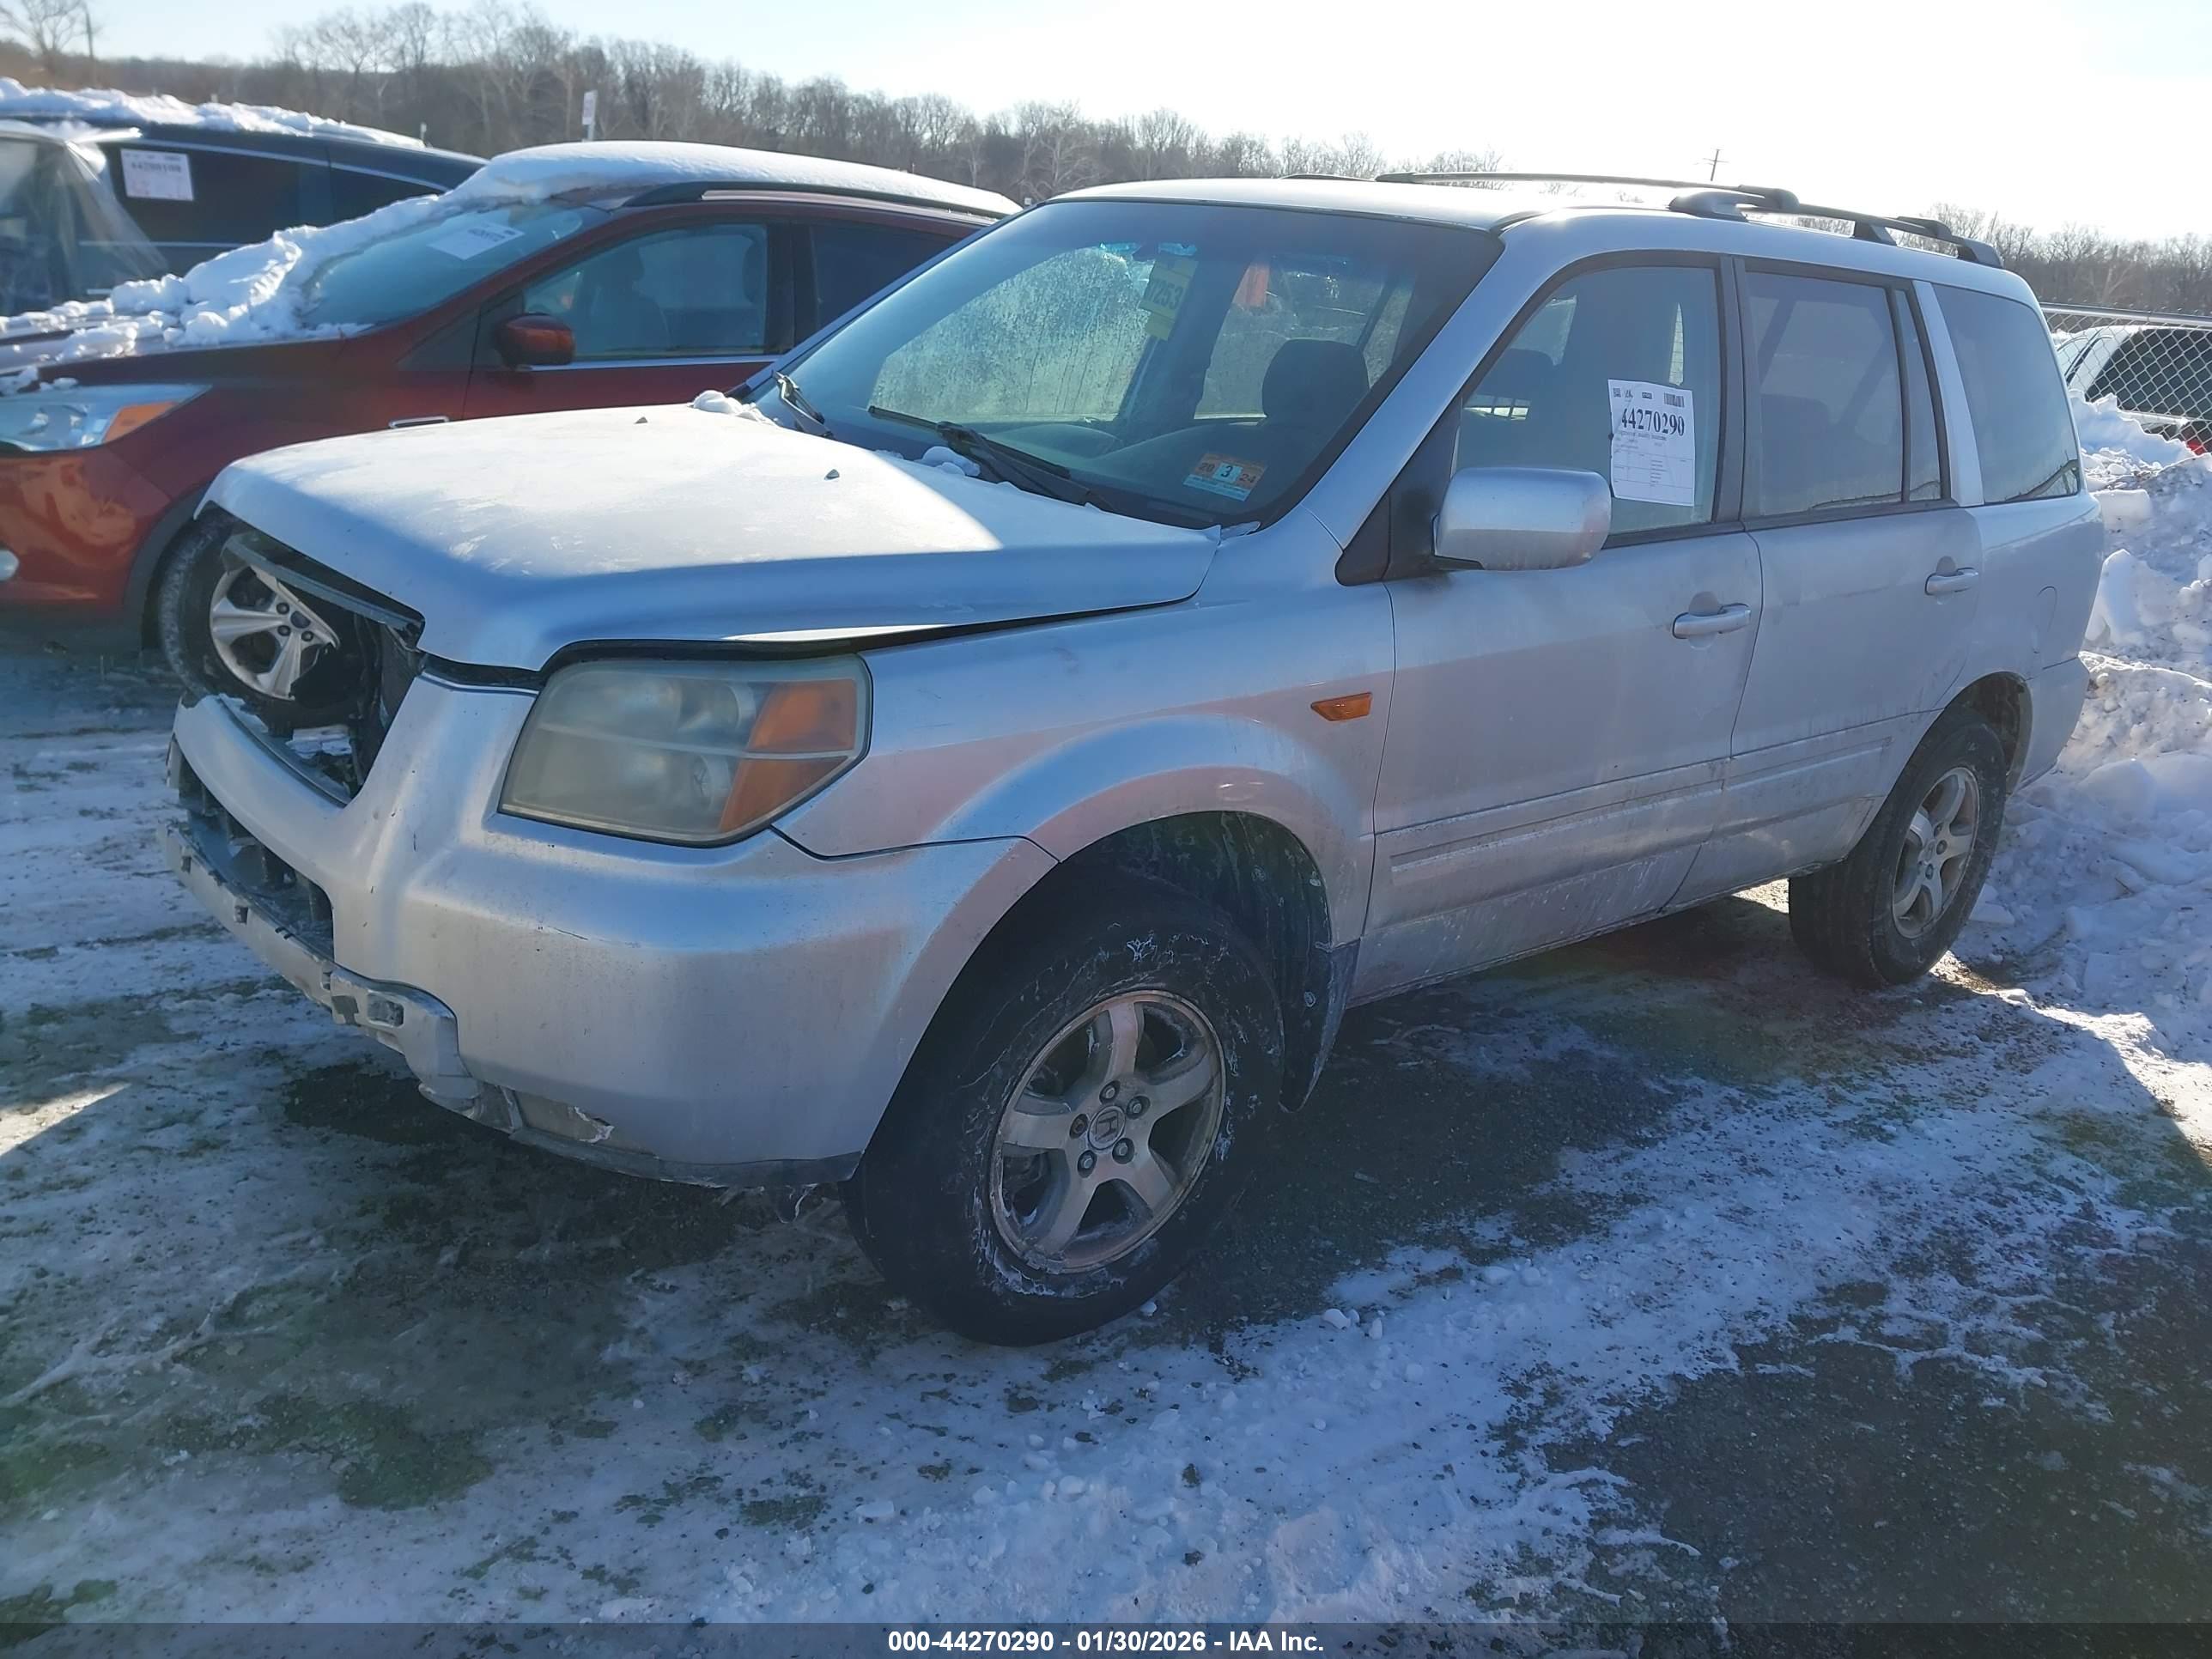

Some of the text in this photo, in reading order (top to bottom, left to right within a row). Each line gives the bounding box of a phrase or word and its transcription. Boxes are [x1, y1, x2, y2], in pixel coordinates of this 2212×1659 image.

[1621, 408, 1685, 436] 44270290
[1199, 462, 1256, 483] 20 3 24
